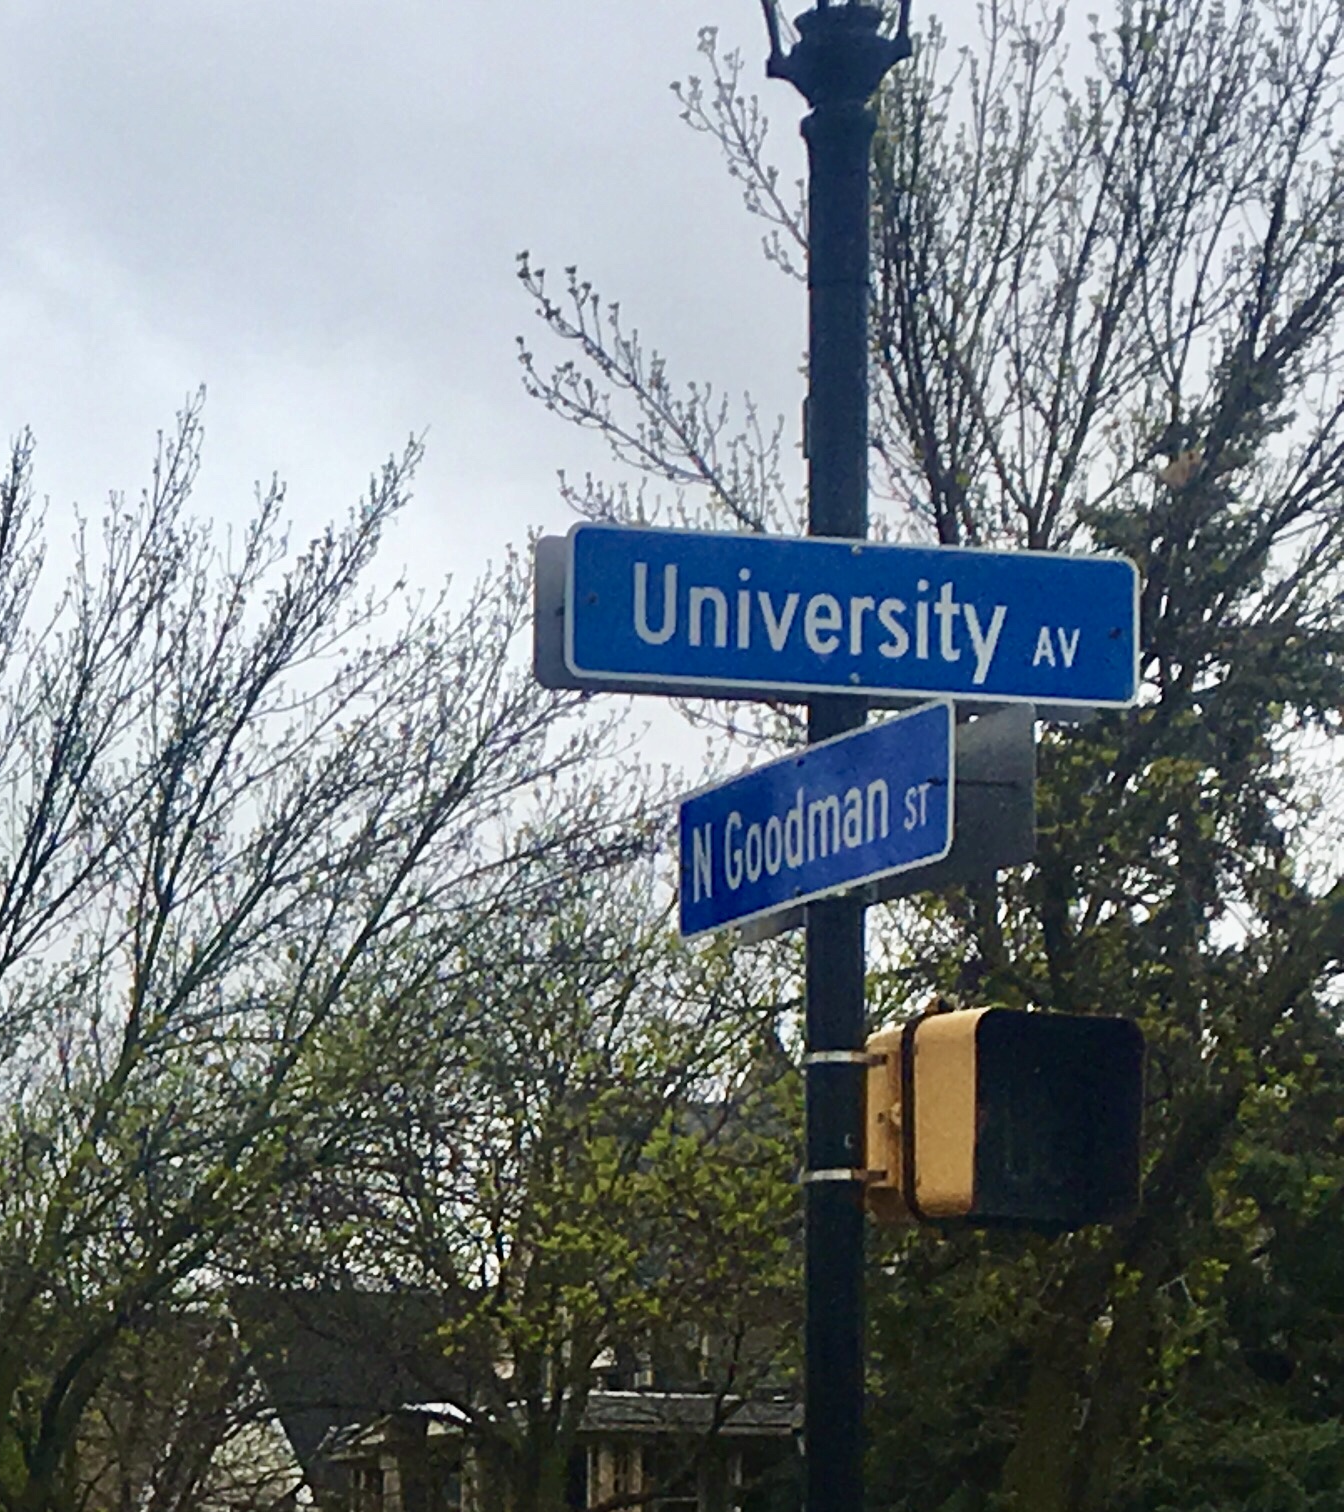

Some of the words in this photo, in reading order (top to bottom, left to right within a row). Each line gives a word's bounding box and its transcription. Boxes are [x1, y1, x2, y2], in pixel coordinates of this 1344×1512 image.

[633, 561, 1007, 684] University
[1032, 626, 1080, 668] AV
[692, 822, 712, 902] N
[724, 777, 889, 891] Goodman
[904, 781, 931, 831] ST
